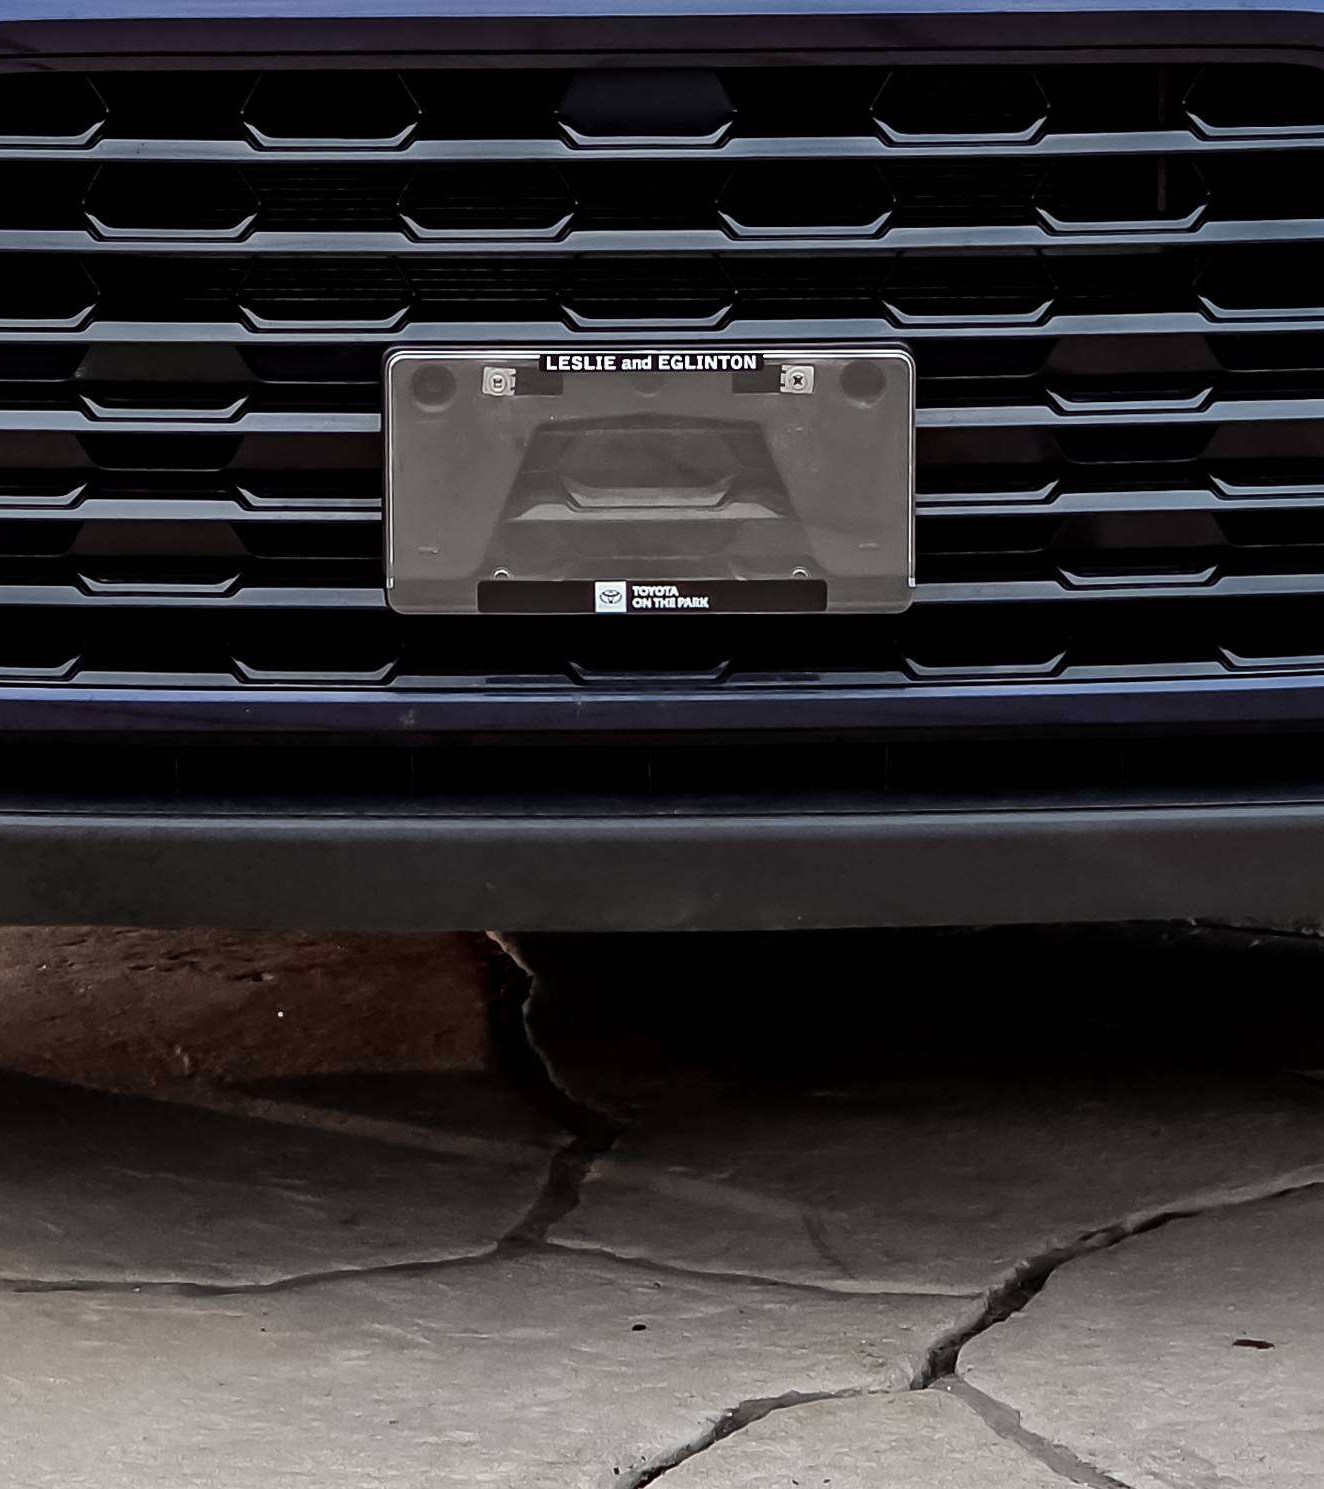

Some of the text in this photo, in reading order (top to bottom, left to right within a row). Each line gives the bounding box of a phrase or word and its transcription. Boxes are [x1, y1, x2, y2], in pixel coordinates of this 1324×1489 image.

[546, 354, 757, 371] LESLIE and EGLINTON
[632, 585, 679, 596] TOYOTA
[632, 597, 710, 608] ON THE PARK
